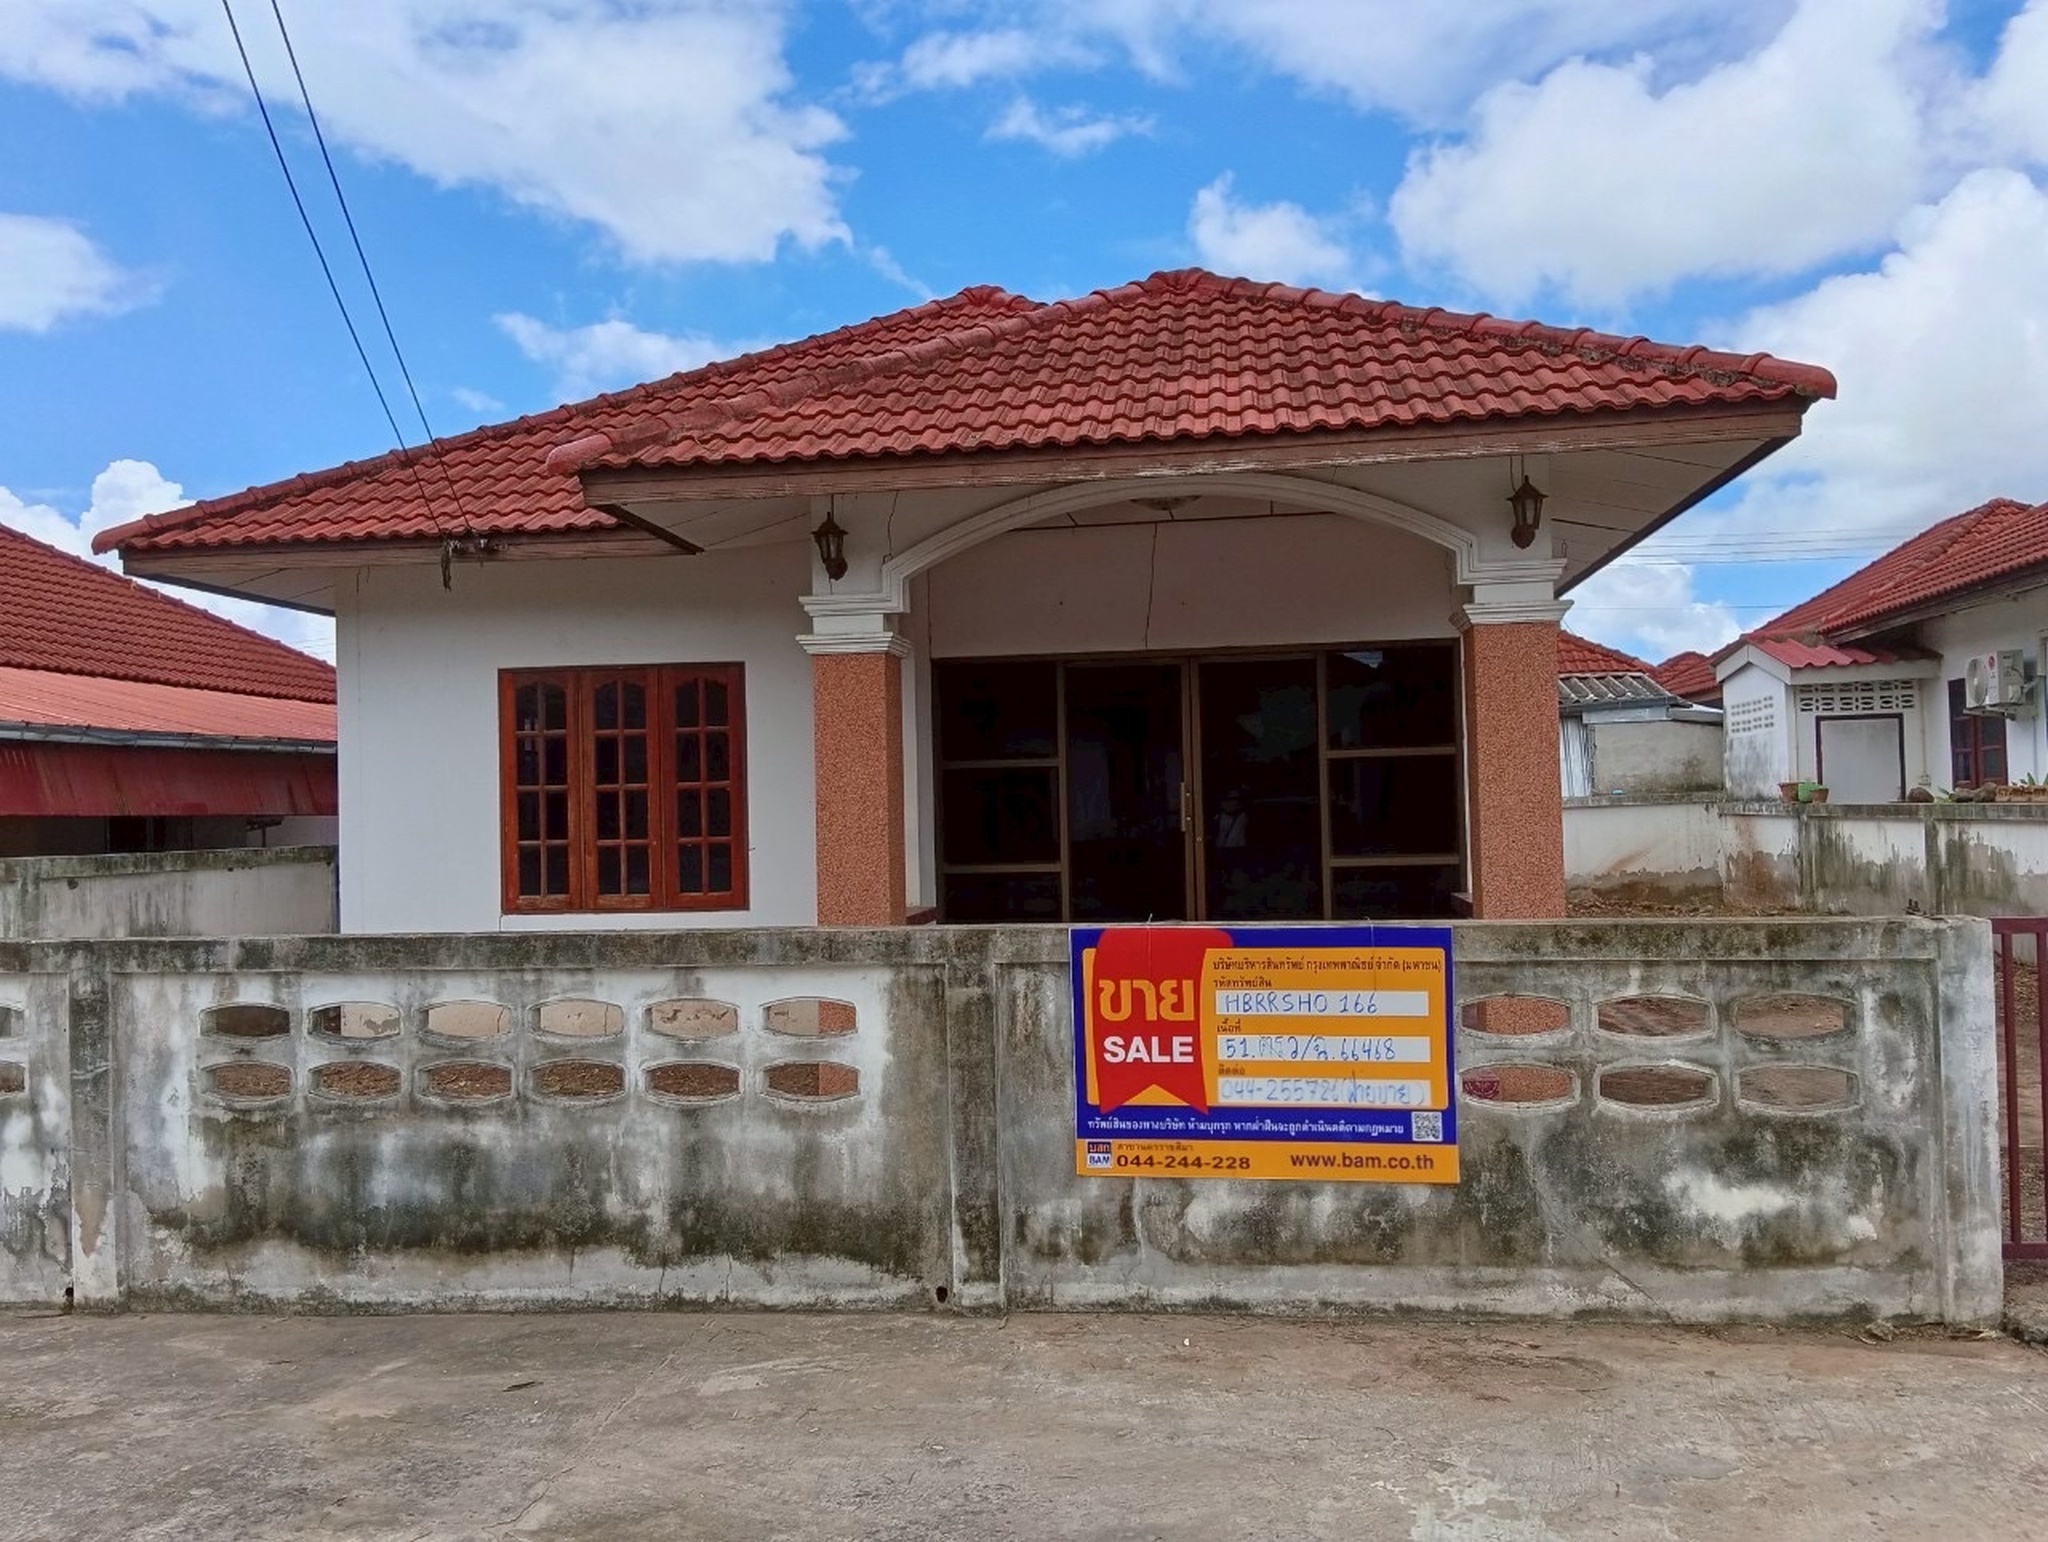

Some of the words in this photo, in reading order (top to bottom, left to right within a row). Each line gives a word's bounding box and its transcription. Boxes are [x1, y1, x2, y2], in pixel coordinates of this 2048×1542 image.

[1306, 956, 1374, 974] กรุงเทพพาณิชย์
[1376, 956, 1401, 970] จำกัด
[1402, 960, 1441, 972] (มหาชน)
[1213, 976, 1272, 988] รหัสทรัพย์สิน
[1099, 979, 1194, 1021] ขาย
[1339, 992, 1377, 1013] 166
[1216, 1018, 1242, 1033] เนื้อที่
[1103, 1035, 1195, 1063] SALE
[1218, 1063, 1246, 1076] ติดต่อ
[1087, 1116, 1187, 1130] ทรัพย์สินของทางบริษัท
[1187, 1117, 1232, 1134] ห้ามบุกรุก
[1089, 1154, 1110, 1165] BAM
[1116, 1154, 1251, 1170] 044-244-228
[1290, 1152, 1434, 1170] www.bam.co.th
